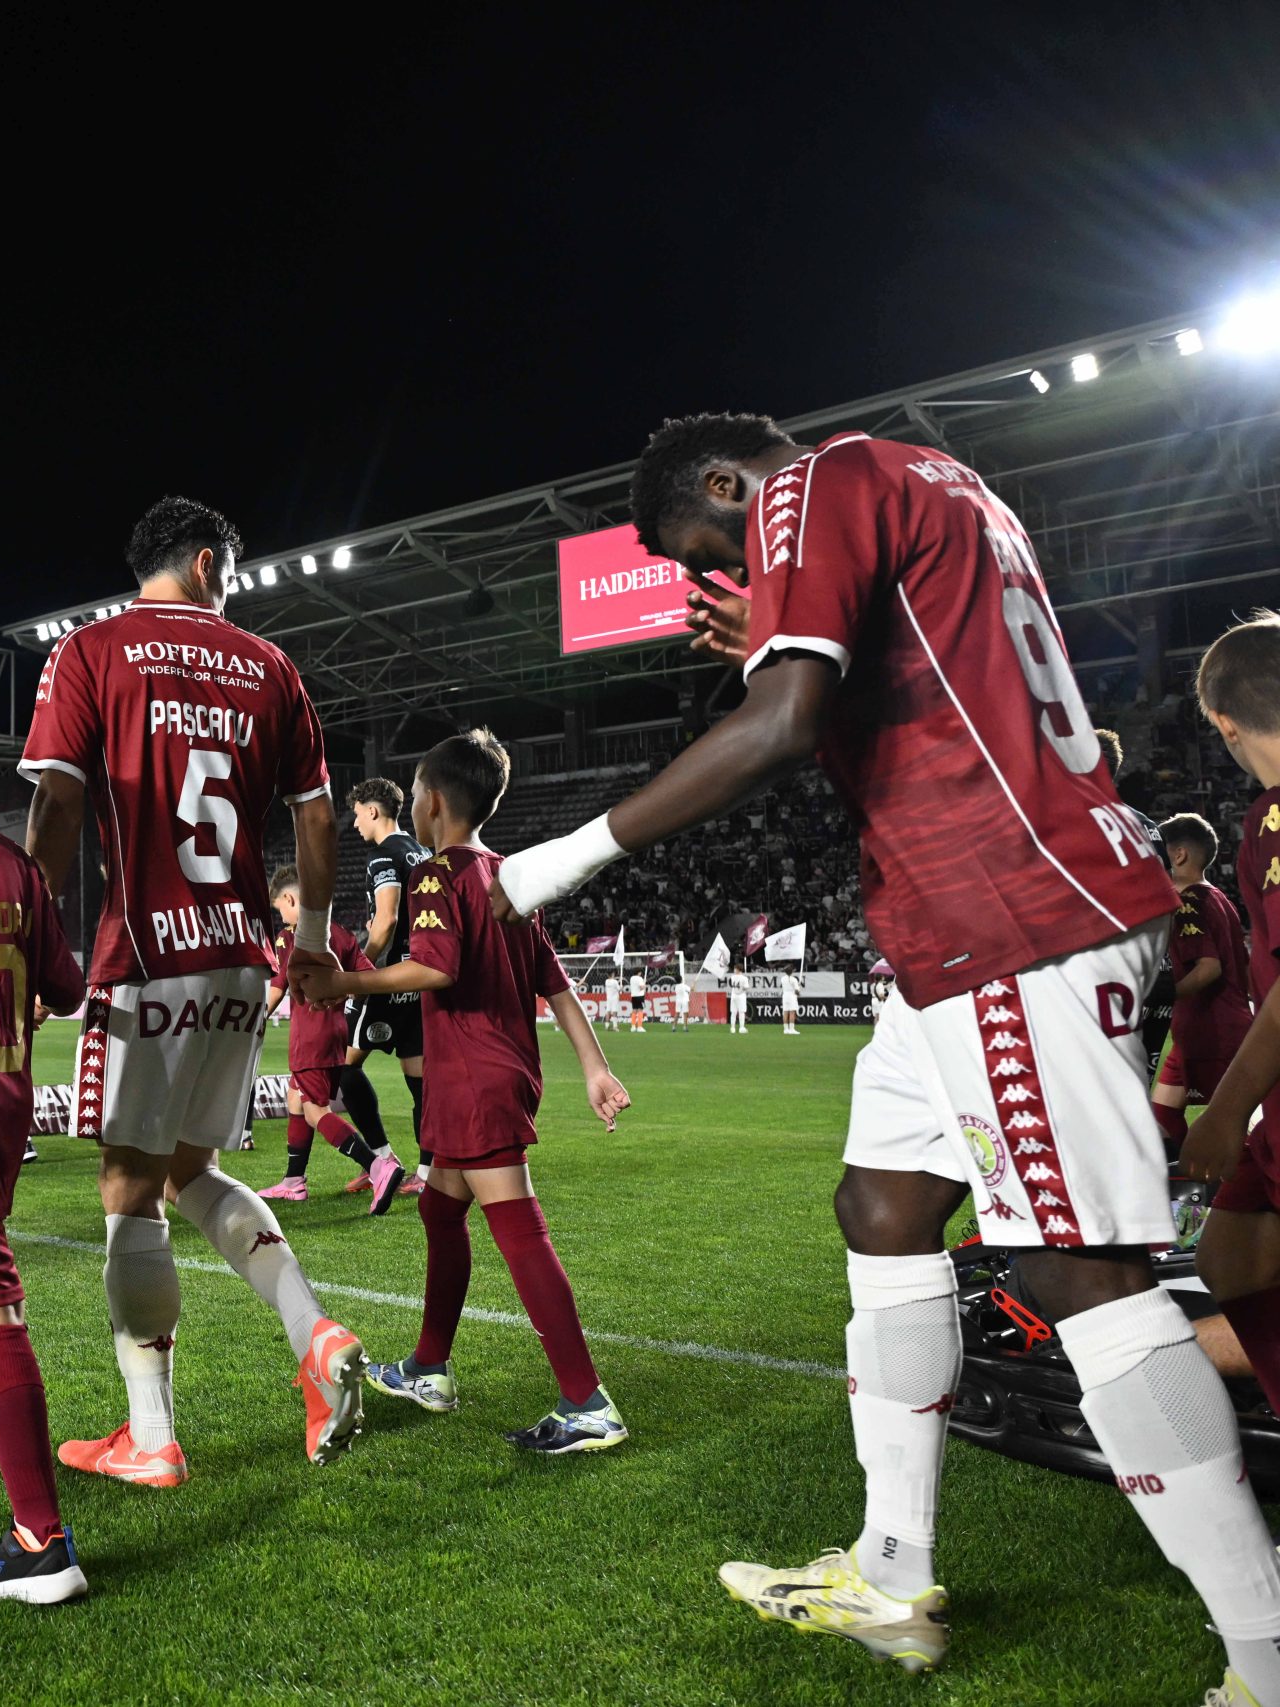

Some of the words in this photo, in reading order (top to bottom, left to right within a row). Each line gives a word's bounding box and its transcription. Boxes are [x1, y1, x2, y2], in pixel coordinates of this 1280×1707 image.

[580, 562, 671, 601] HAIDEEE
[124, 641, 265, 680] HOFFMAN
[138, 665, 211, 682] UNDERFLOOR
[213, 674, 260, 691] HEATING
[1003, 587, 1101, 774] 9
[176, 749, 238, 884] 5
[139, 995, 265, 1039] DACRI
[756, 1005, 828, 1018] TRAORIA
[833, 1005, 857, 1018] Roz
